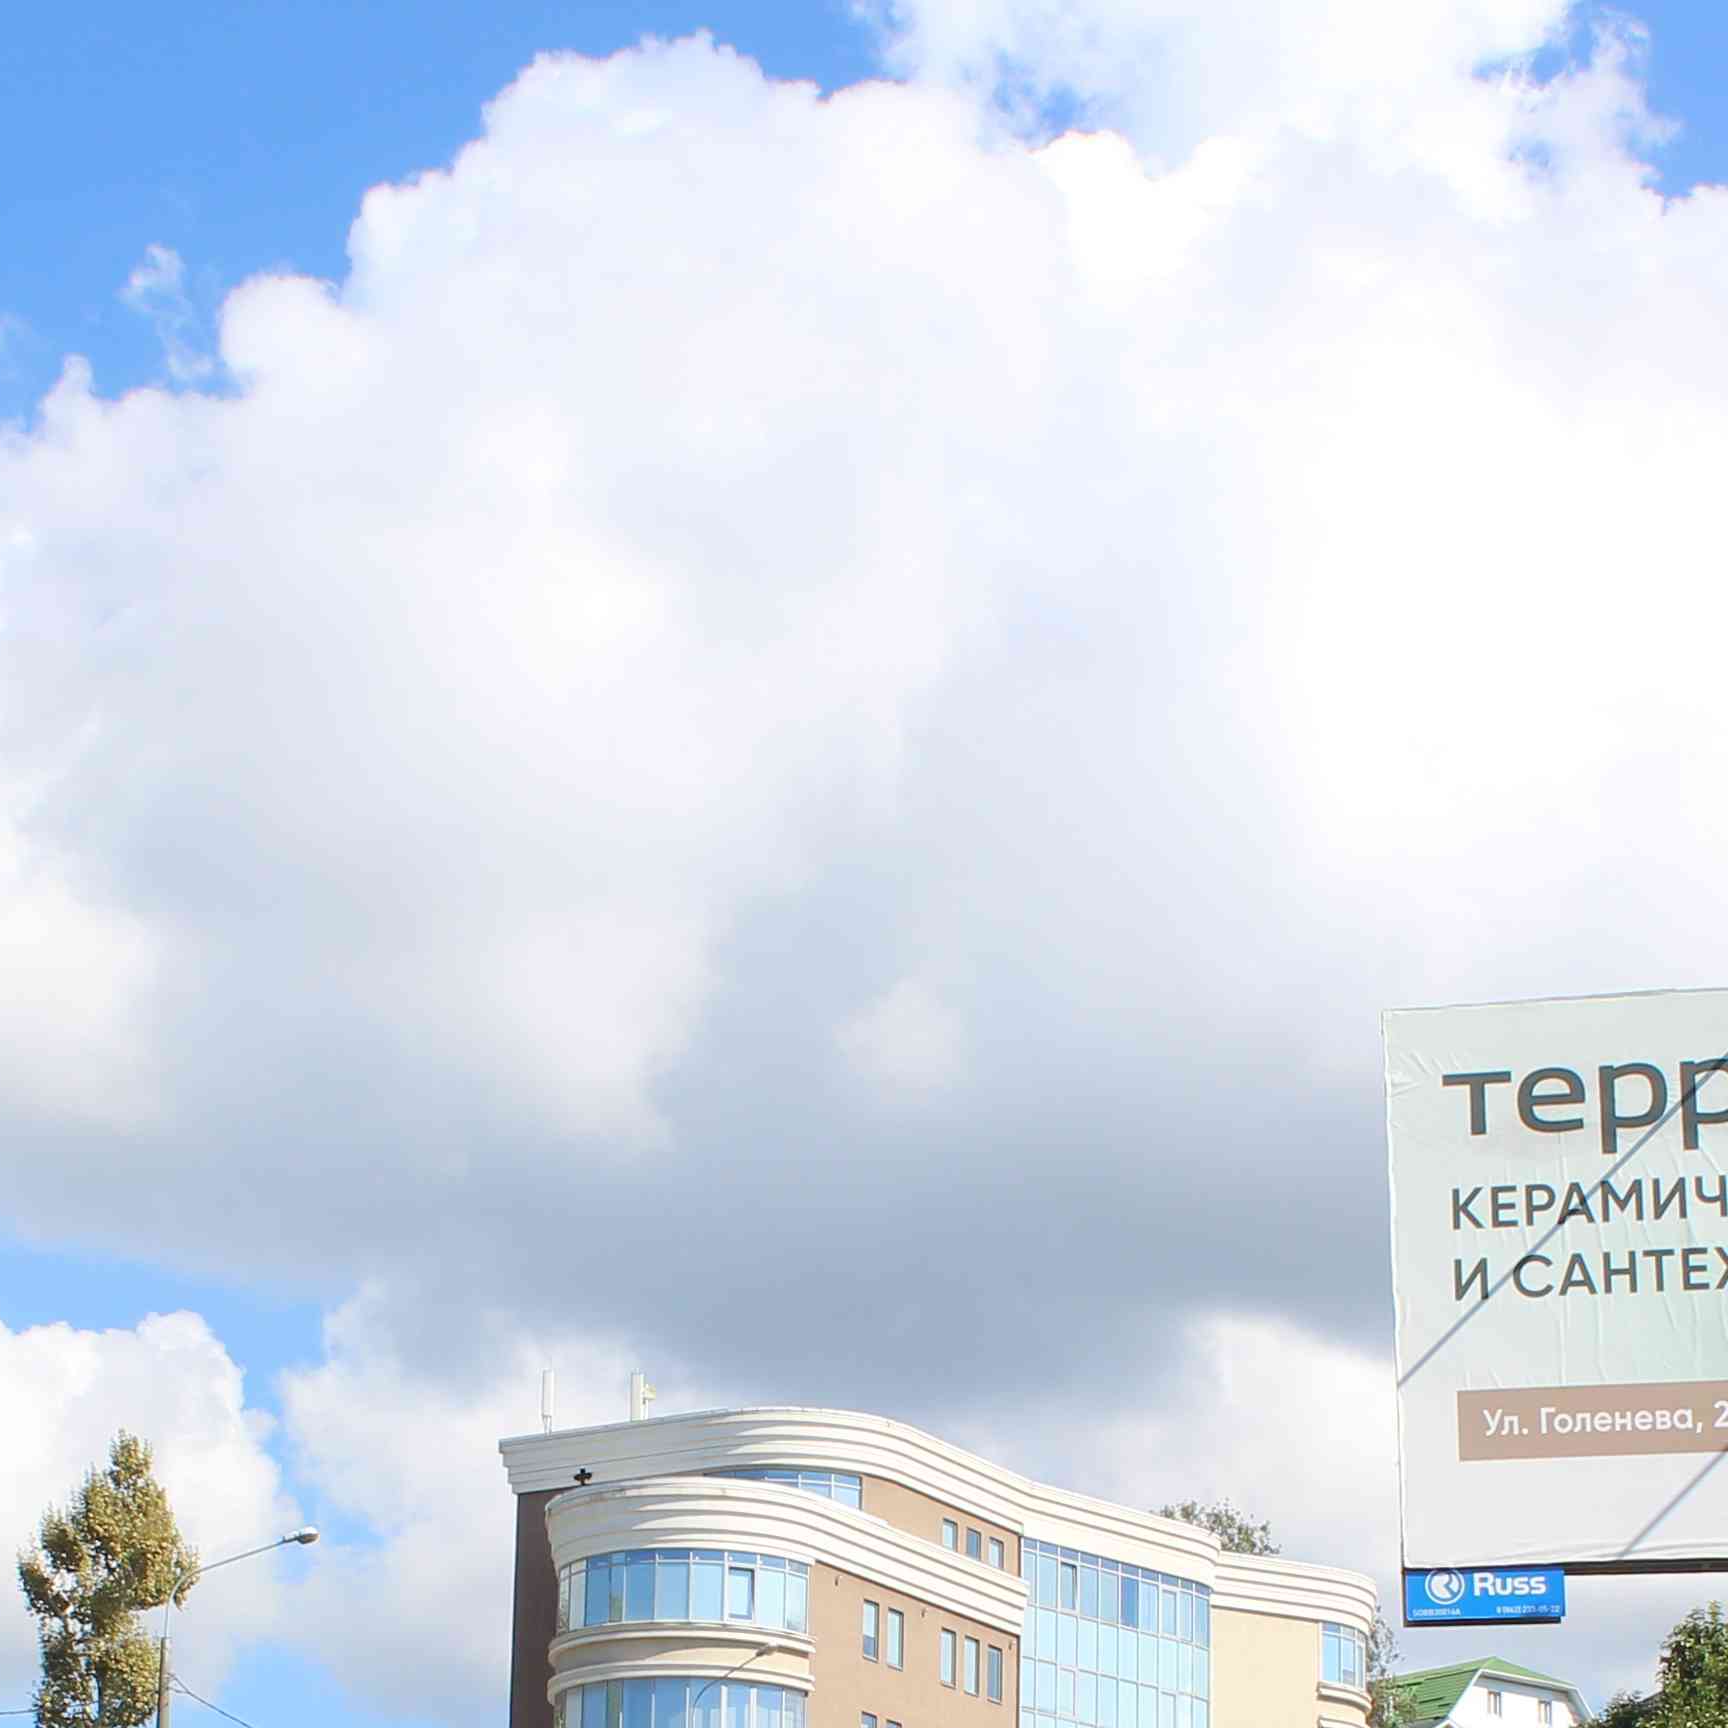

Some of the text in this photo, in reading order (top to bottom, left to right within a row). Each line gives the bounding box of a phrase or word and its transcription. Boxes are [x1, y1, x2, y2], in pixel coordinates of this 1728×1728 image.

[1453, 1257, 1490, 1301] И
[1482, 1408, 1529, 1437] Ул.
[1539, 1406, 1703, 1434] Голенева,
[1472, 1572, 1547, 1597] Russ
